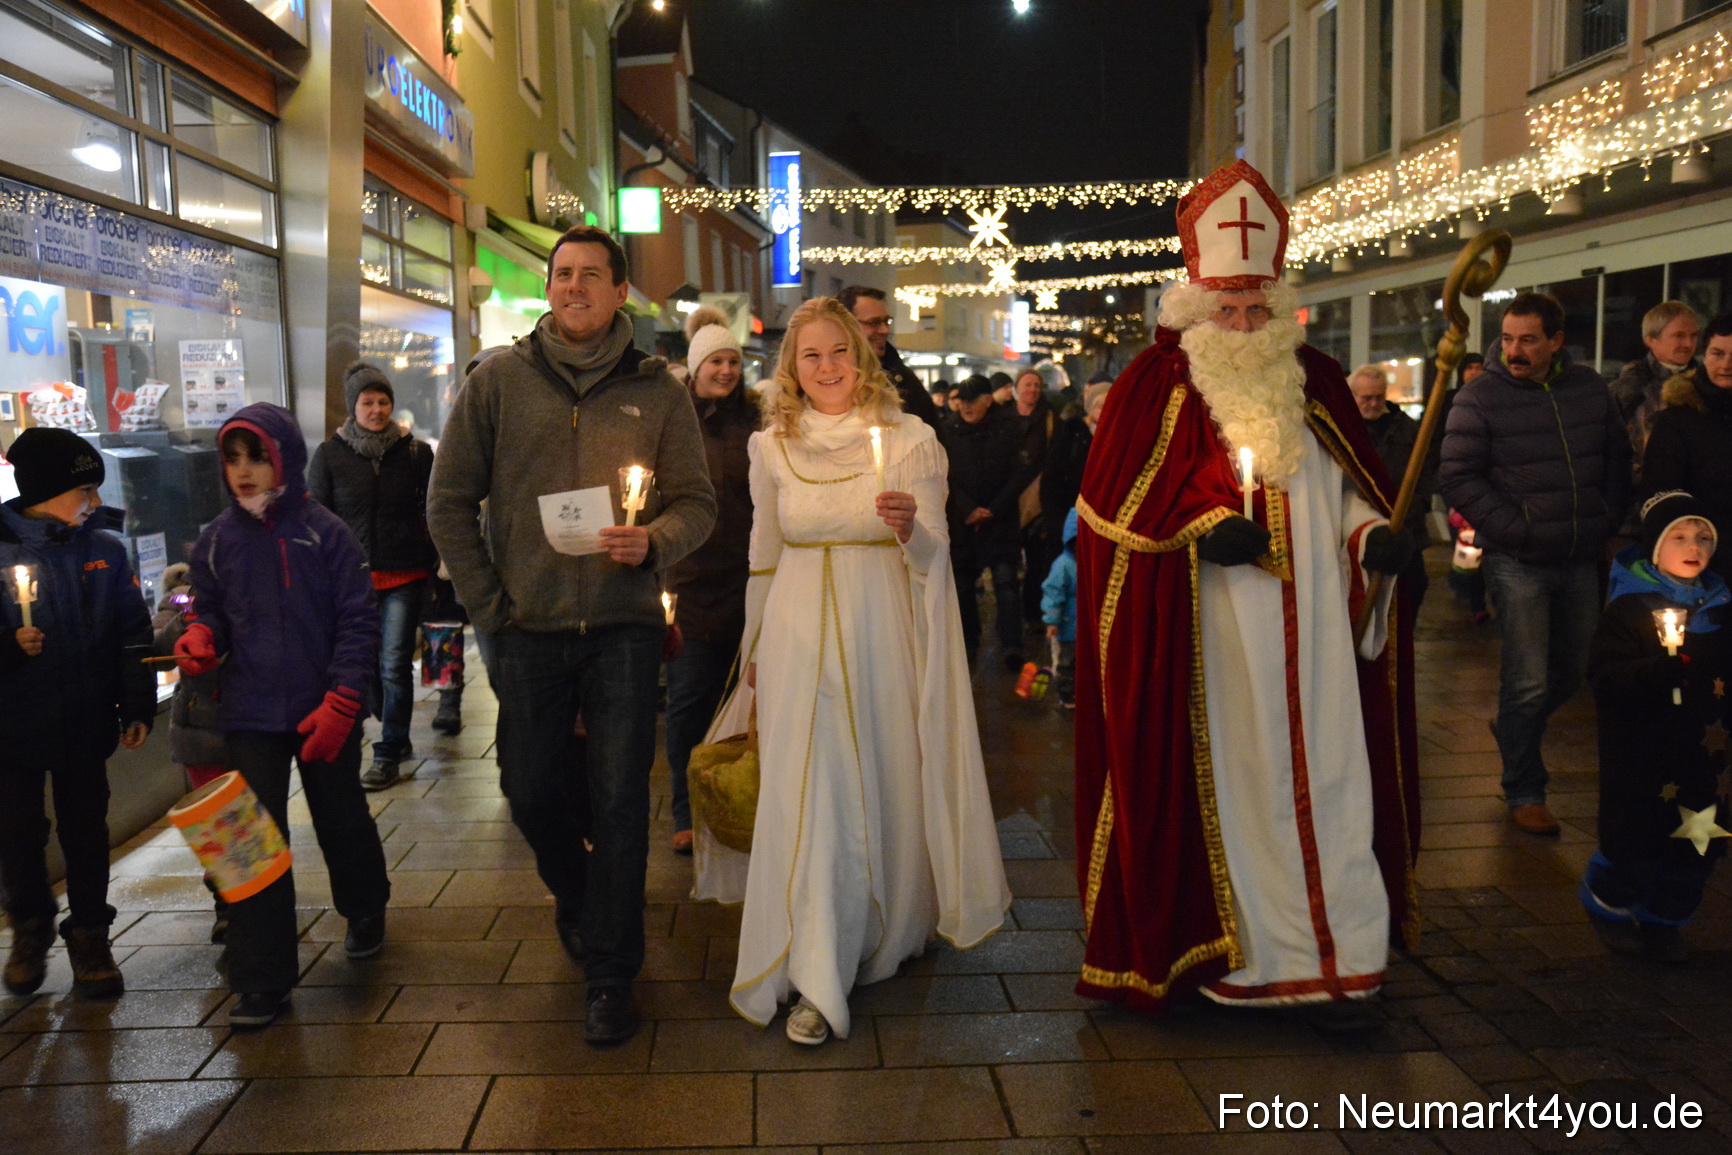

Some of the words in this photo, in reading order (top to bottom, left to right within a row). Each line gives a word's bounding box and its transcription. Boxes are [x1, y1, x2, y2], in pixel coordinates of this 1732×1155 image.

[95, 212, 140, 243] brother
[0, 234, 33, 259] ZIERT
[39, 243, 92, 271] REDUZIERT
[97, 257, 143, 281] REDUZIERT
[45, 225, 85, 251] EISKALT
[101, 240, 137, 262] EISKALT
[182, 353, 238, 363] REDUZR
[188, 343, 232, 353] EISKAL
